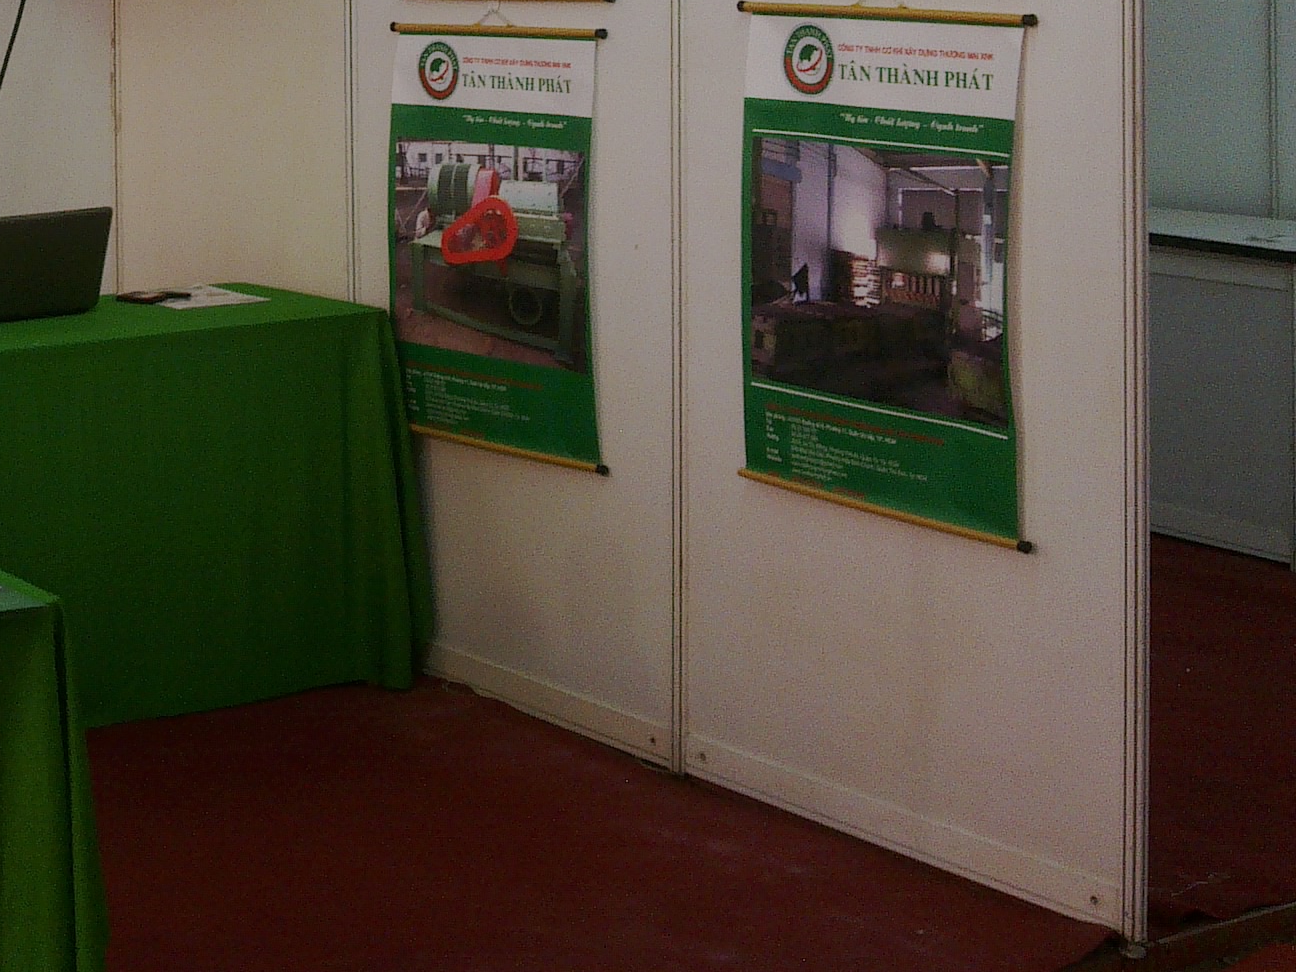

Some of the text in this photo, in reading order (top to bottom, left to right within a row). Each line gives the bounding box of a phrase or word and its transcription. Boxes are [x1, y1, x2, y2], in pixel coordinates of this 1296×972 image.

[462, 70, 572, 94] TÂN THÀNH PHÁT
[838, 60, 995, 91] TÂN THÀNH PHÁT
